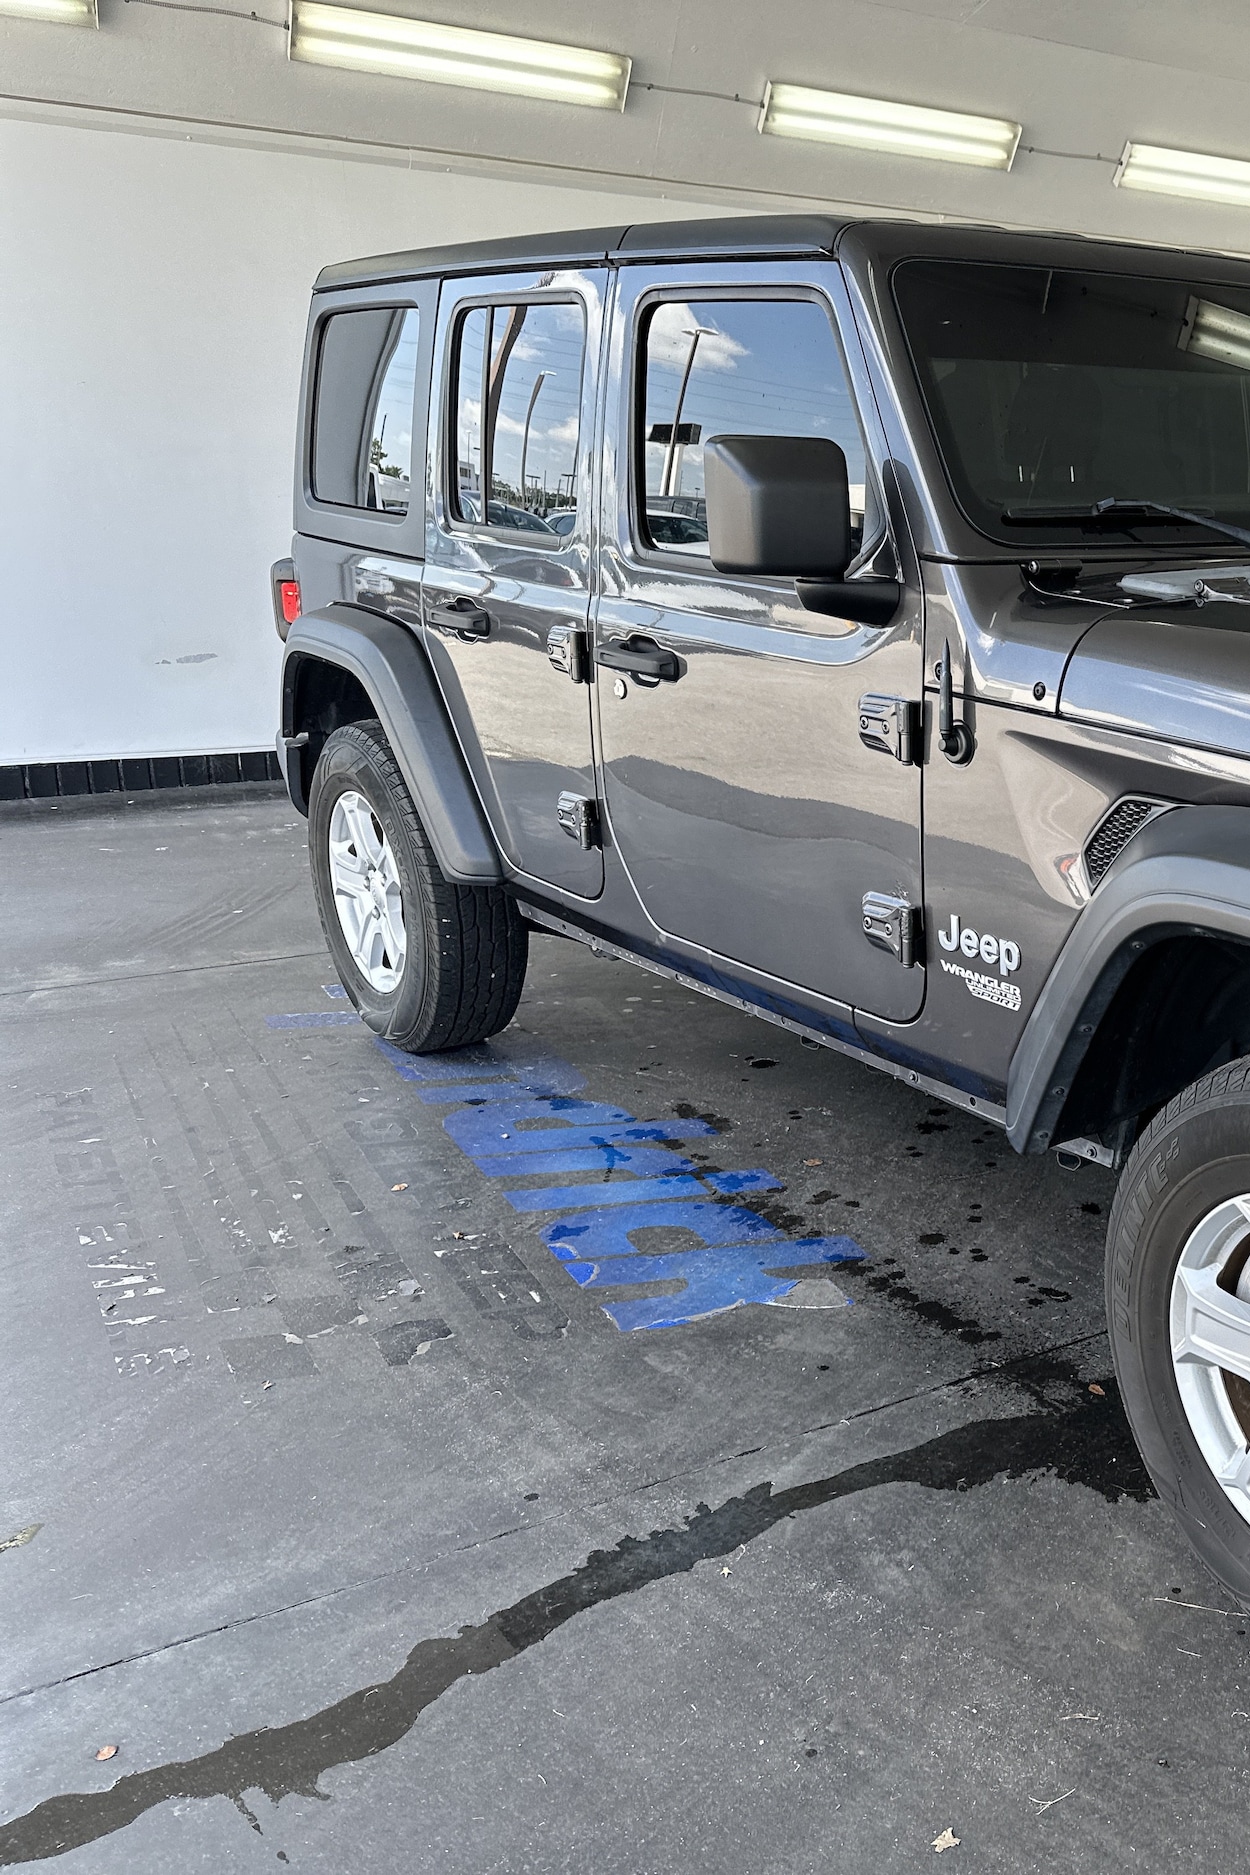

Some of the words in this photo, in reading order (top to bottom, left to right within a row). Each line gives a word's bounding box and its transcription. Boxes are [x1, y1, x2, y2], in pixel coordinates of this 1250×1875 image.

[938, 913, 1021, 977] Jeep
[940, 958, 1021, 997] WRANGLER
[965, 978, 1022, 1002] UNLIMITED
[971, 988, 1020, 1009] SPORT
